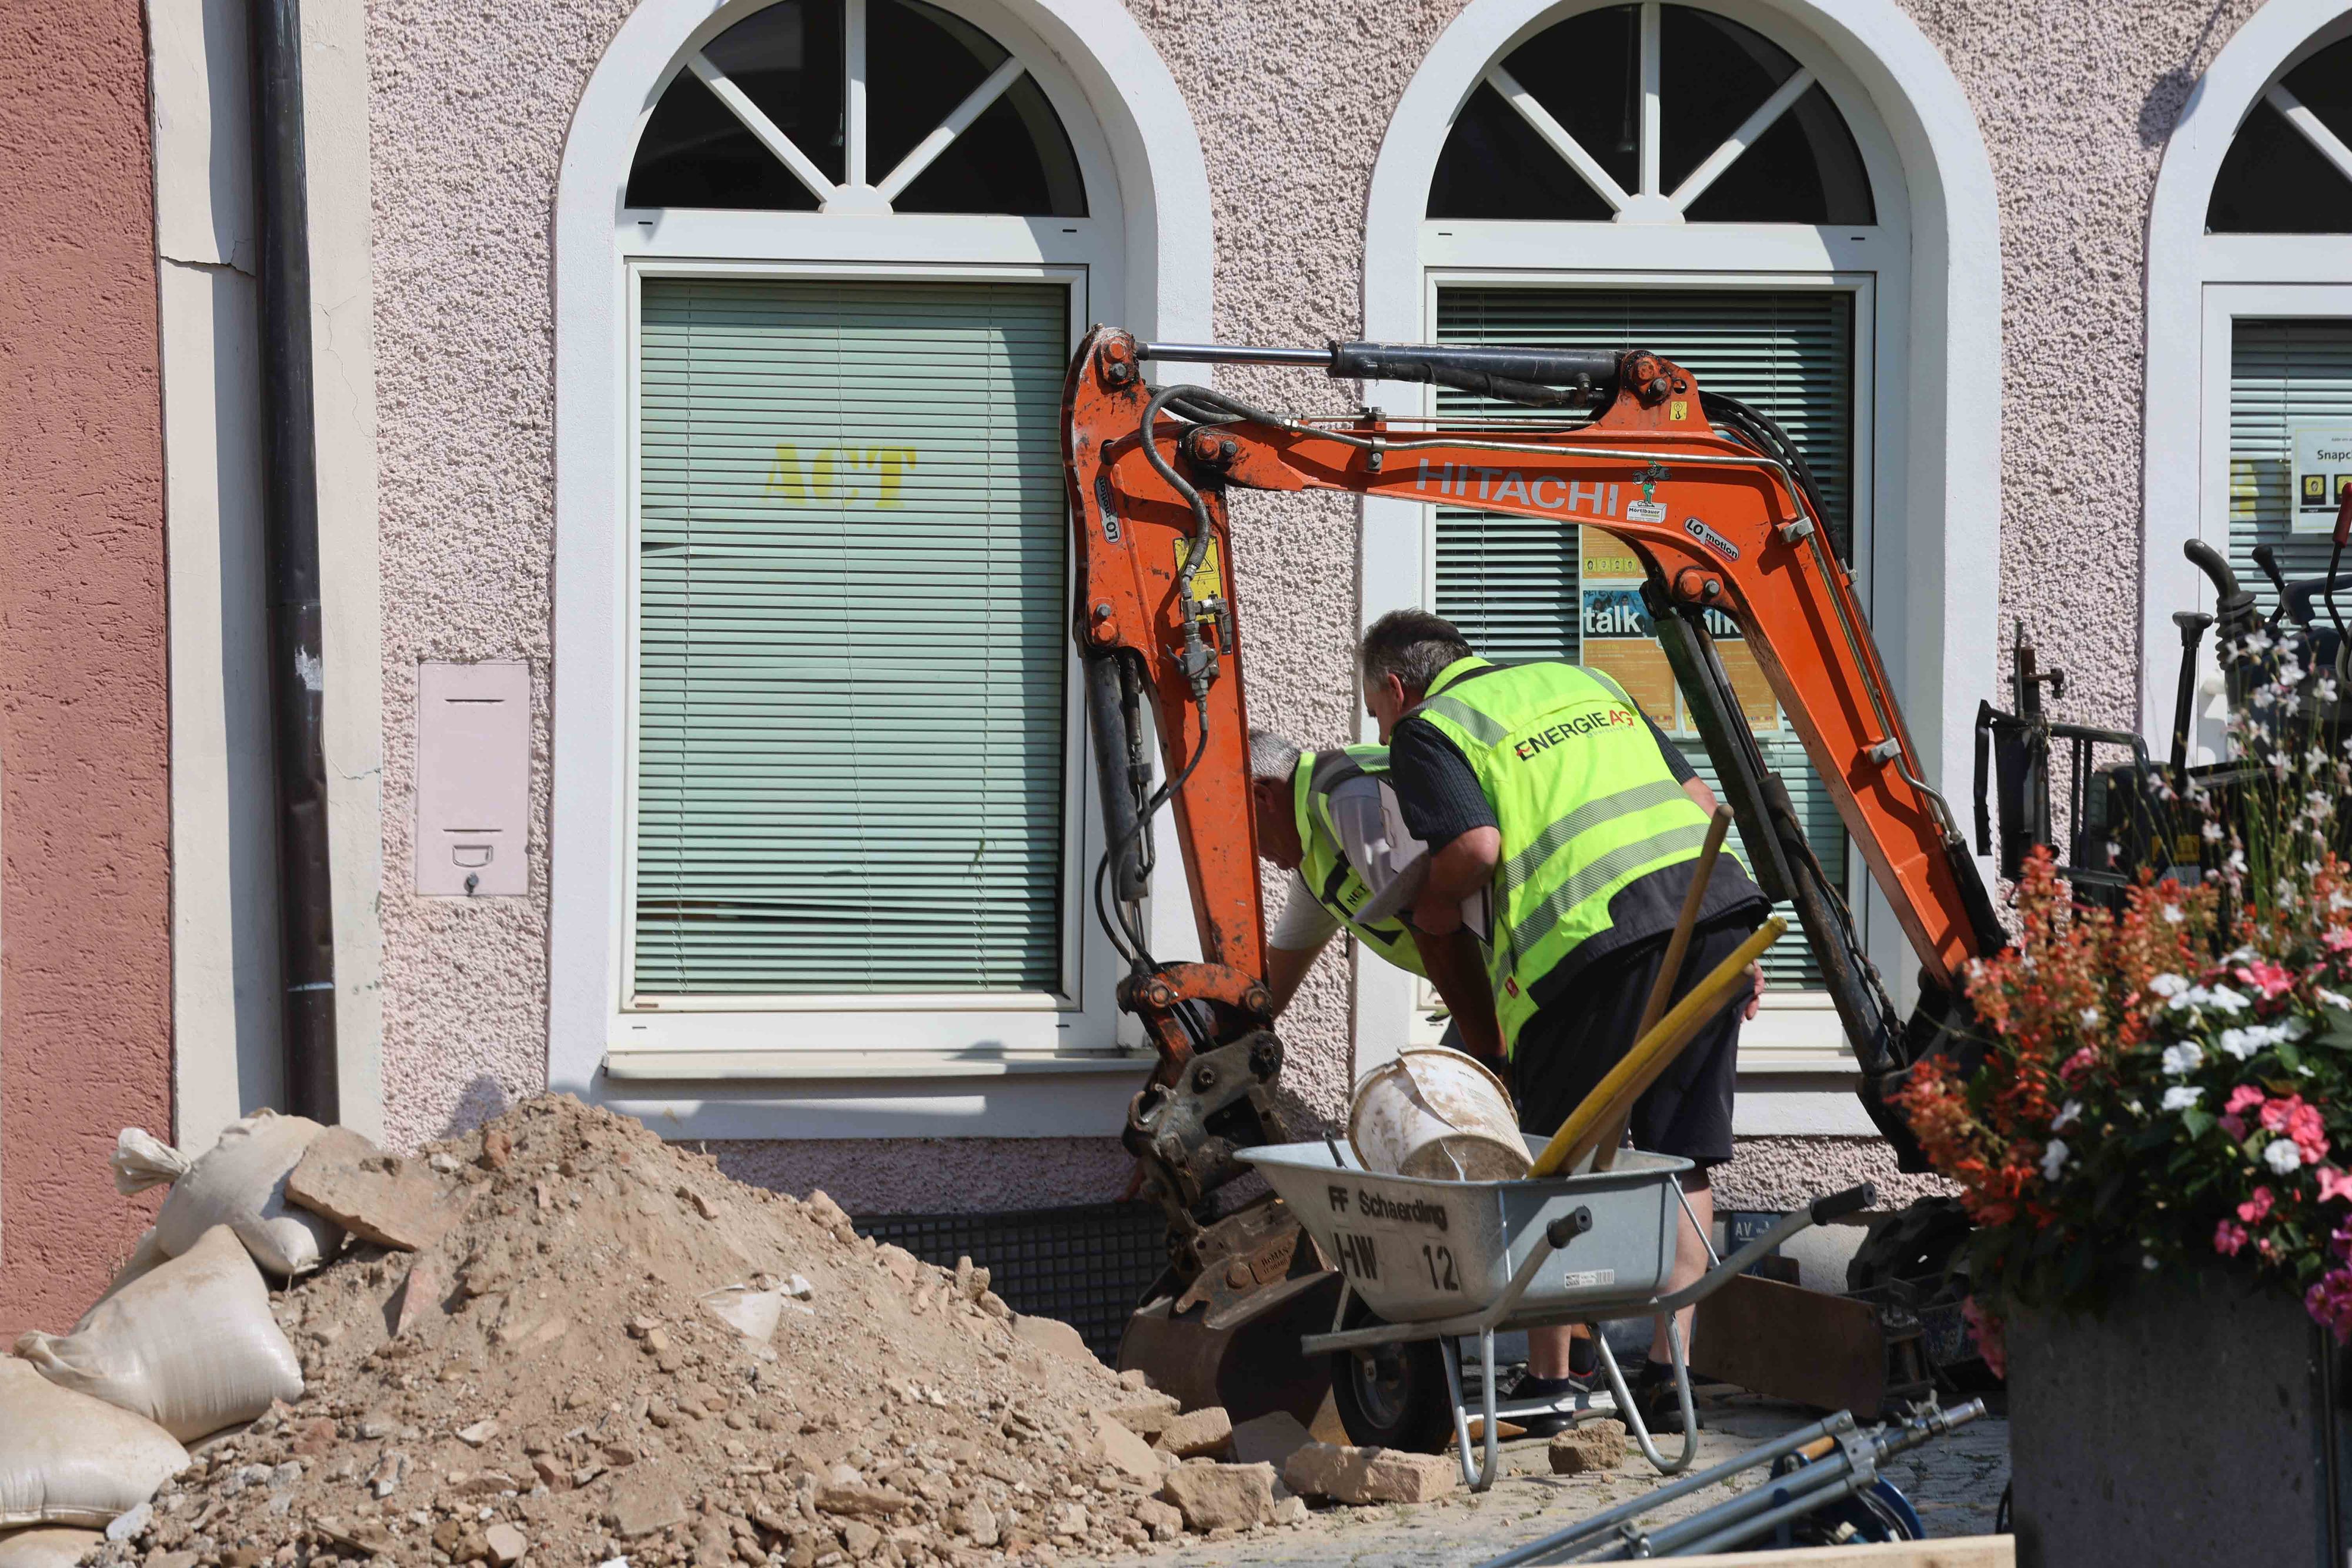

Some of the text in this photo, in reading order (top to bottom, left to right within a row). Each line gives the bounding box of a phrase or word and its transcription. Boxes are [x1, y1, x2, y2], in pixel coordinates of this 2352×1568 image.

[762, 443, 917, 509] ACT
[2317, 450, 2352, 463] Snapc
[1416, 458, 1618, 517] HITACHI
[1583, 605, 1642, 633] talk
[1328, 1185, 1448, 1232] FF Schaerding
[1333, 1232, 1459, 1291] HW 12
